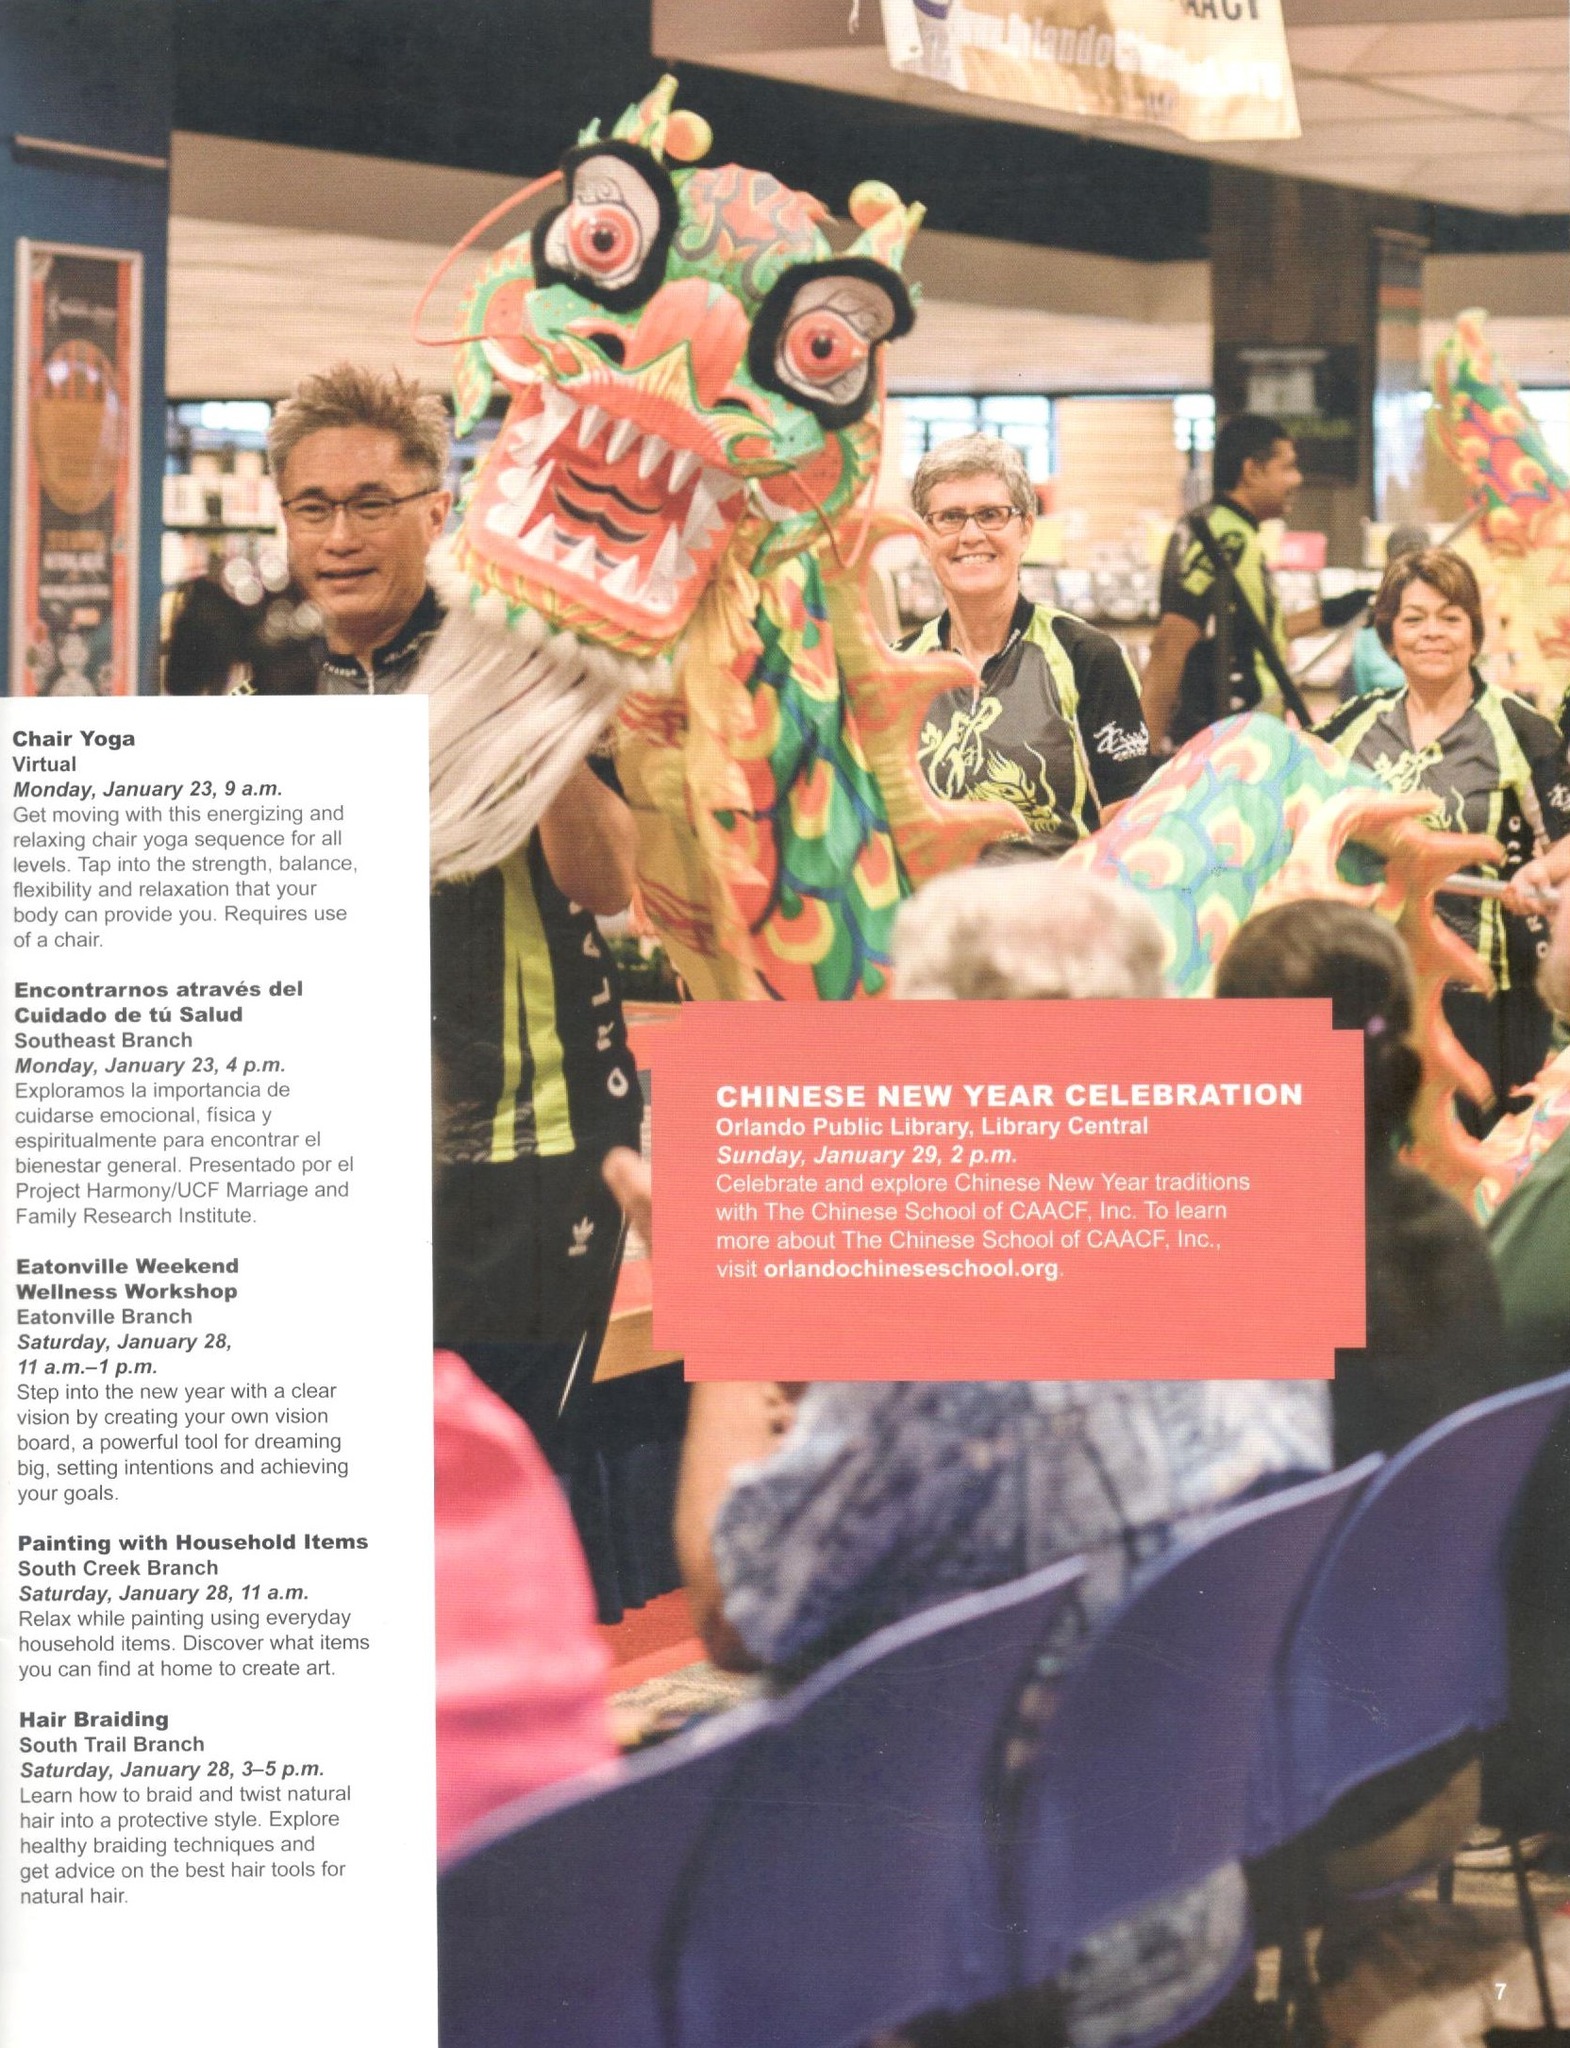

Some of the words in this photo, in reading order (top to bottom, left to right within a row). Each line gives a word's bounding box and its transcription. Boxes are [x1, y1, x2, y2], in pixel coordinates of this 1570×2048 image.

[12, 730, 73, 748] Chair
[79, 730, 136, 751] Yoga
[11, 755, 77, 773] Virtual
[12, 780, 96, 803] Monday,
[102, 780, 184, 801] January
[189, 780, 217, 801] 23,
[224, 780, 236, 797] 9
[241, 783, 282, 797] a.m.
[13, 806, 47, 823] Get
[52, 809, 119, 827] moving
[125, 805, 162, 823] with
[168, 805, 201, 822] this
[207, 804, 303, 826] energizing
[309, 804, 344, 822] and
[13, 931, 32, 948] of
[37, 935, 48, 948] a
[54, 931, 106, 948] chair.
[14, 981, 169, 999] Encontrarnos
[176, 980, 262, 998] através
[268, 980, 303, 997] del
[14, 1006, 107, 1024] Cuidado
[114, 1006, 142, 1023] de
[148, 1006, 172, 1023] tú
[179, 1006, 243, 1023] Salud
[14, 1032, 116, 1049] Southeast
[122, 1031, 193, 1048] Branch
[14, 1057, 98, 1079] Monday,
[104, 1057, 186, 1077] January
[191, 1056, 219, 1077] 23,
[225, 1056, 238, 1073] 4
[242, 1060, 285, 1077] p.m.
[15, 1082, 125, 1103] Exploramos
[131, 1082, 147, 1098] la
[153, 1081, 261, 1102] importancia
[267, 1081, 291, 1098] de
[716, 1084, 866, 1109] CHINESE
[877, 1084, 953, 1108] NEW
[962, 1084, 1055, 1108] YEAR
[1065, 1082, 1303, 1107] CELEBRATION
[715, 1117, 806, 1137] Orlando
[812, 1116, 884, 1136] Public
[890, 1116, 974, 1141] Library,
[981, 1116, 1061, 1140] Library
[1067, 1115, 1148, 1135] Central
[716, 1145, 806, 1170] Sunday,
[813, 1145, 906, 1169] January
[911, 1144, 942, 1168] 29,
[950, 1144, 964, 1164] 2
[968, 1148, 1017, 1168] p.m.
[16, 1182, 81, 1203] Project
[87, 1181, 220, 1203] Harmony/UCF
[226, 1181, 309, 1202] Marriage
[314, 1181, 349, 1198] and
[716, 1173, 818, 1193] Celebrate
[824, 1173, 864, 1193] and
[870, 1173, 948, 1197] explore
[954, 1172, 1041, 1192] Chinese
[1048, 1172, 1095, 1192] New
[1101, 1172, 1149, 1192] Year
[1154, 1172, 1250, 1191] traditions
[16, 1207, 77, 1229] Family
[83, 1207, 172, 1224] Research
[179, 1206, 258, 1224] Institute.
[715, 1202, 758, 1221] with
[764, 1201, 805, 1221] The
[811, 1201, 898, 1221] Chinese
[905, 1201, 976, 1221] School
[982, 1200, 1004, 1220] of
[1009, 1200, 1092, 1223] CAACF,
[1100, 1200, 1138, 1220] Inc.
[1143, 1200, 1169, 1220] To
[1175, 1200, 1227, 1220] learn
[716, 1235, 770, 1250] more
[777, 1230, 836, 1250] about
[841, 1229, 883, 1249] The
[889, 1230, 975, 1249] Chinese
[982, 1229, 1054, 1249] School
[1060, 1229, 1081, 1249] of
[1086, 1229, 1170, 1251] CAACF,
[1178, 1229, 1220, 1250] Inc.,
[16, 1257, 129, 1275] Eatonville
[135, 1257, 239, 1274] Weekend
[716, 1260, 758, 1278] visit
[15, 1283, 118, 1301] Wellness
[124, 1282, 238, 1303] Workshop
[16, 1308, 116, 1325] Eatonville
[122, 1307, 193, 1325] Branch
[16, 1333, 110, 1355] Saturday,
[116, 1333, 199, 1354] January
[203, 1332, 232, 1353] 28,
[18, 1358, 38, 1375] 11
[114, 1361, 157, 1379] p.m.
[17, 1383, 60, 1404] Step
[65, 1384, 99, 1400] into
[105, 1383, 134, 1400] the
[140, 1386, 179, 1400] new
[184, 1386, 226, 1404] year
[230, 1382, 268, 1399] with
[273, 1385, 285, 1399] a
[291, 1382, 338, 1399] clear
[17, 1488, 59, 1506] your
[63, 1484, 120, 1506] goals.
[18, 1534, 111, 1556] Painting
[118, 1534, 168, 1551] with
[175, 1533, 296, 1551] Household
[304, 1533, 369, 1550] Items
[17, 1559, 77, 1577] South
[83, 1559, 141, 1577] Creek
[147, 1559, 219, 1576] Branch
[18, 1584, 112, 1607] Saturday,
[118, 1584, 200, 1605] January
[205, 1584, 233, 1605] 28,
[241, 1584, 261, 1601] 11
[267, 1587, 309, 1601] a.m.
[19, 1610, 72, 1627] Relax
[77, 1609, 126, 1627] while
[131, 1609, 204, 1631] painting
[210, 1608, 260, 1630] using
[266, 1608, 352, 1630] everyday
[19, 1635, 115, 1653] household
[121, 1635, 177, 1652] items.
[183, 1634, 265, 1651] Discover
[269, 1634, 315, 1651] what
[320, 1633, 370, 1651] items
[19, 1711, 67, 1729] Hair
[74, 1710, 169, 1732] Braiding
[19, 1736, 78, 1754] South
[83, 1736, 127, 1753] Trail
[133, 1735, 205, 1753] Branch
[20, 1761, 113, 1783] Saturday,
[120, 1761, 202, 1782] January
[206, 1760, 235, 1781] 28,
[281, 1763, 324, 1781] p.m.
[20, 1787, 73, 1804] Learn
[79, 1786, 118, 1803] how
[122, 1787, 141, 1803] to
[146, 1785, 193, 1803] braid
[199, 1785, 233, 1803] and
[239, 1785, 282, 1802] twist
[287, 1784, 351, 1802] natural
[20, 1887, 84, 1905] natural
[90, 1887, 131, 1904] hair.
[1494, 1982, 1507, 2001] 7
